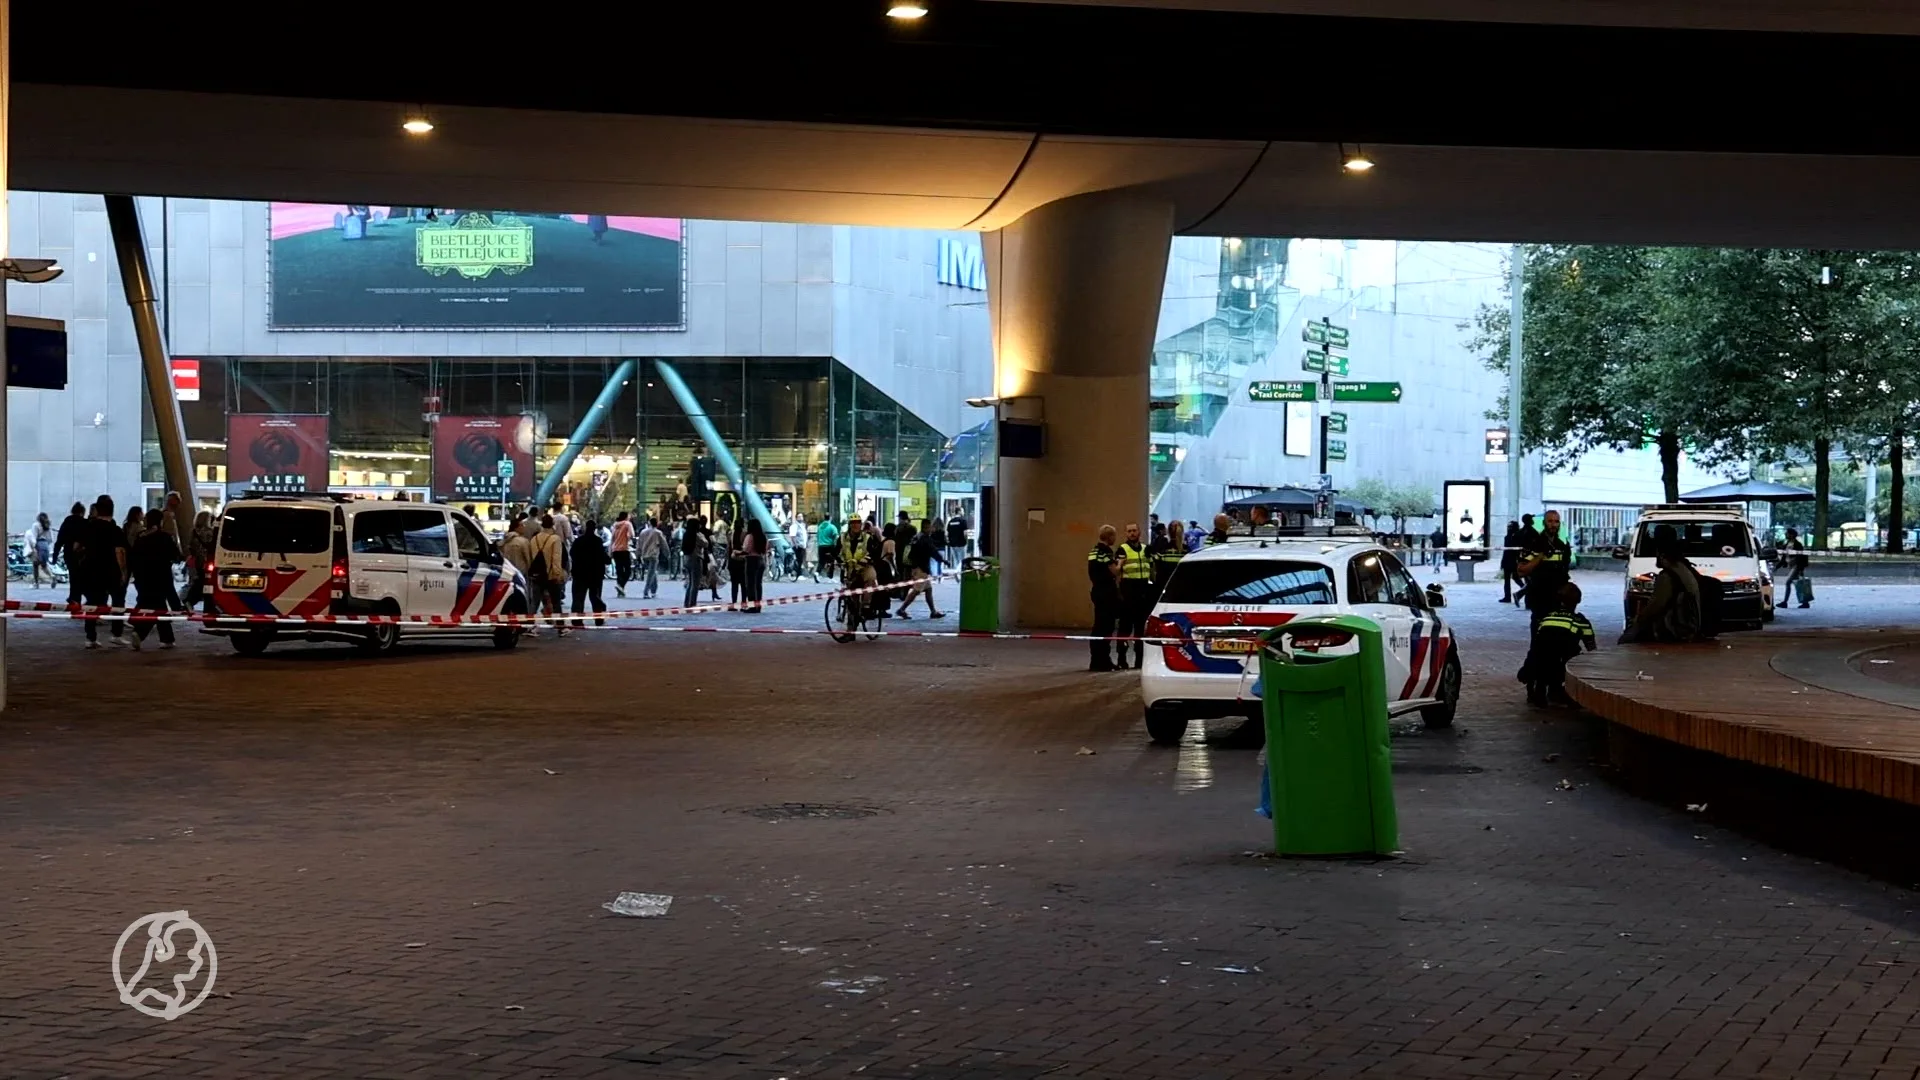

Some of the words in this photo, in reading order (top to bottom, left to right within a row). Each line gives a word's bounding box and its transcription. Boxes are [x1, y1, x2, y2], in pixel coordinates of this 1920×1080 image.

[430, 234, 519, 247] BEETLEJUICE
[430, 247, 519, 261] BEETLEJUICE
[250, 475, 306, 484] ALIEN
